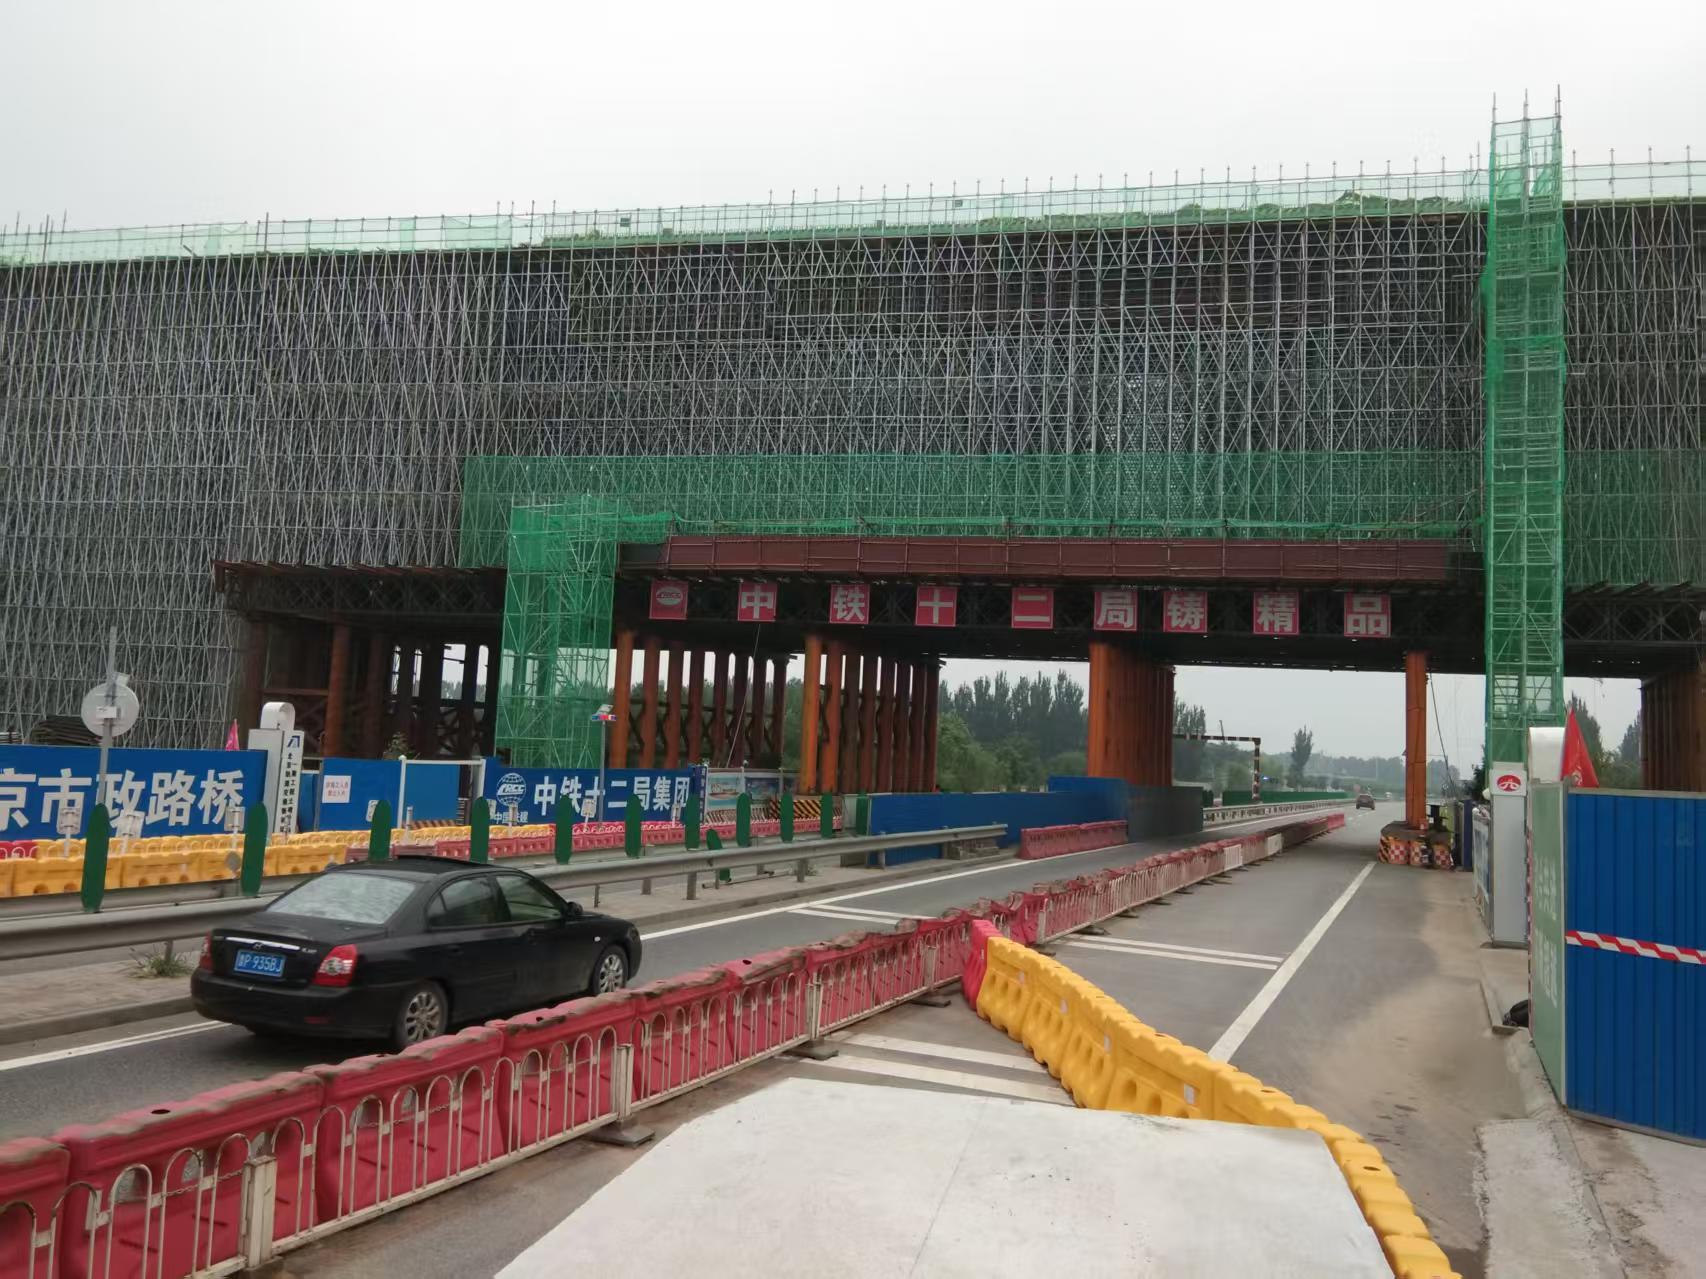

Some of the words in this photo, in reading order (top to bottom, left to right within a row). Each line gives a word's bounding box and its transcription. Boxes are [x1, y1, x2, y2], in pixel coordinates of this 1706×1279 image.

[741, 585, 1388, 635] 中铁十二局铸精品
[534, 775, 691, 817] 中铁十二局集团
